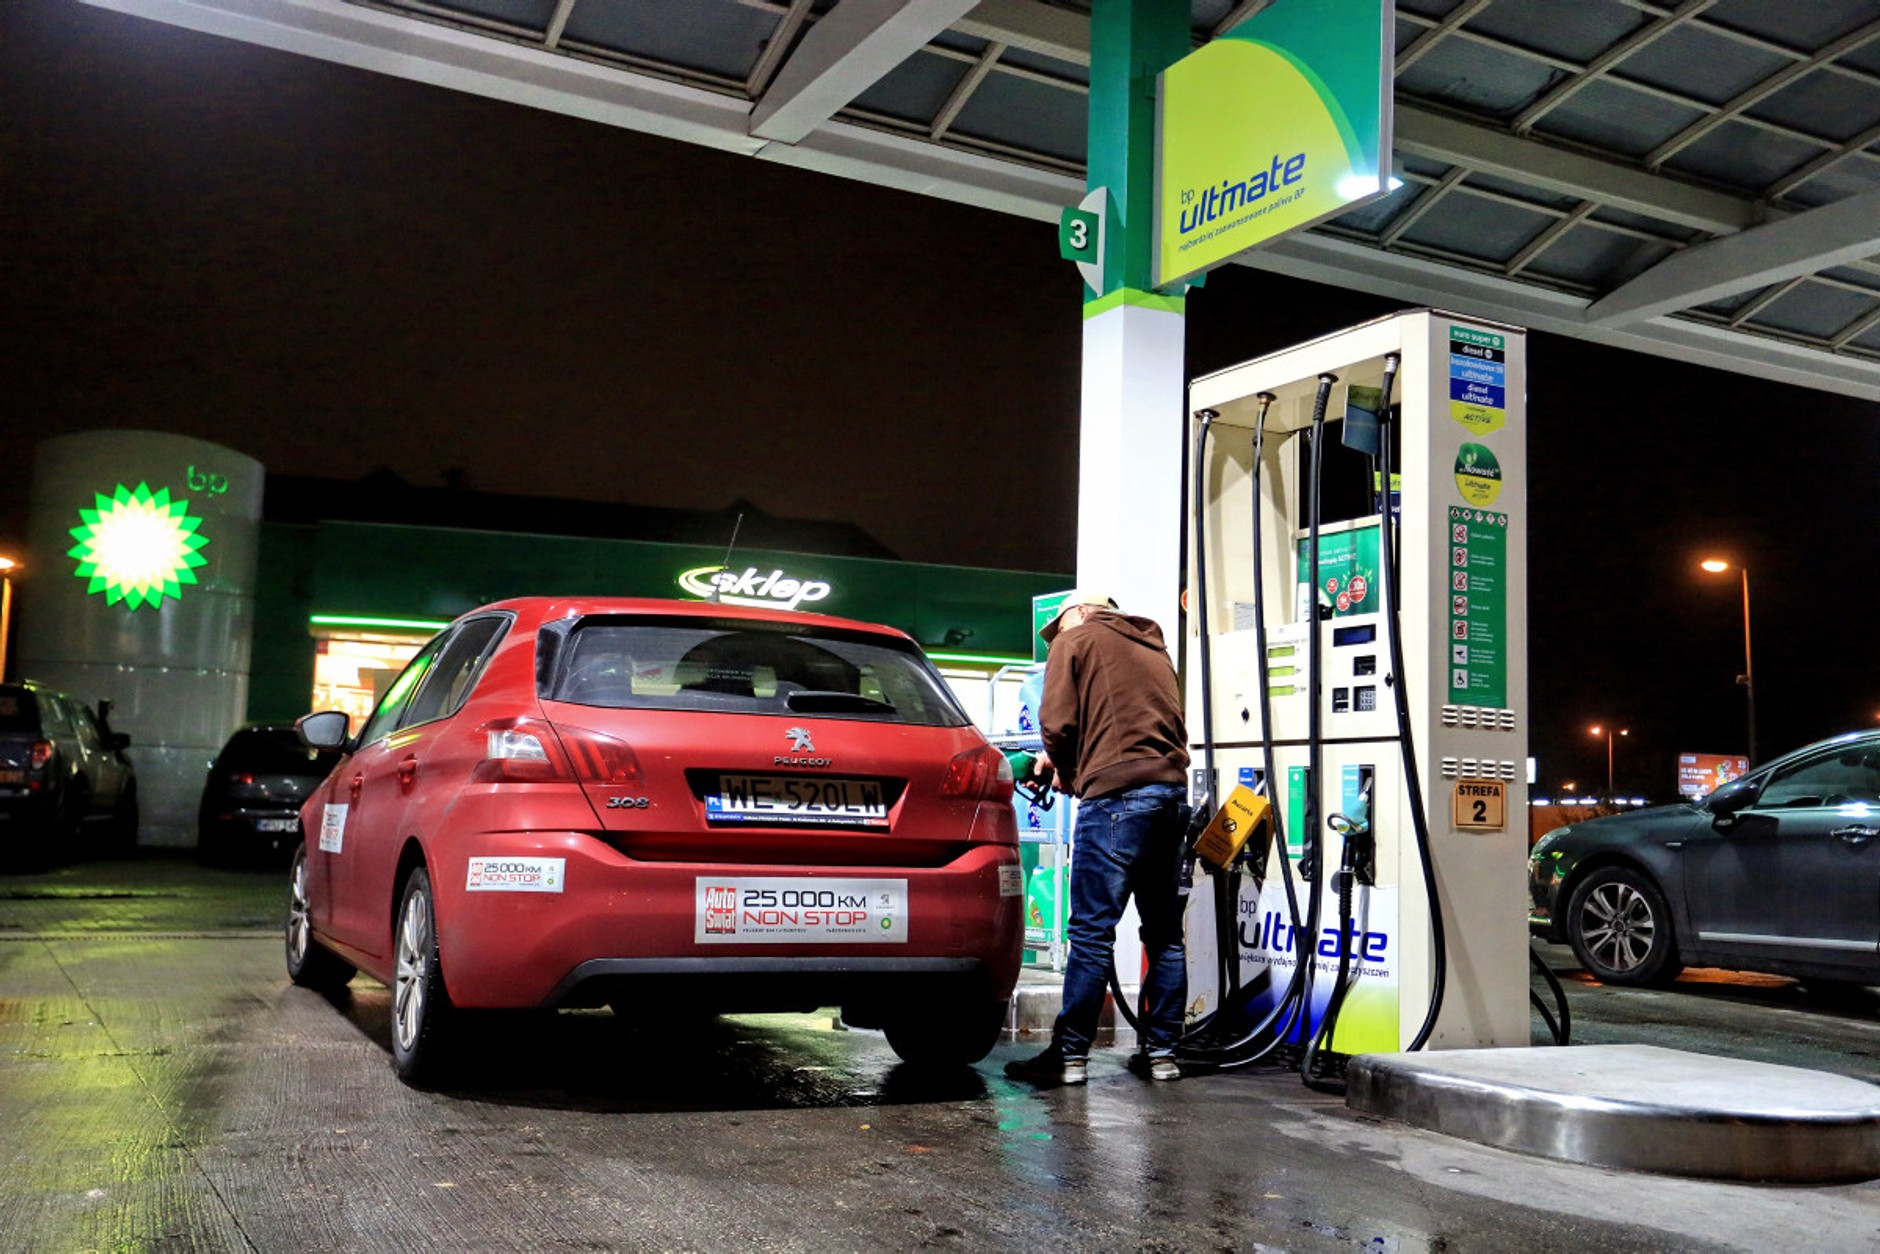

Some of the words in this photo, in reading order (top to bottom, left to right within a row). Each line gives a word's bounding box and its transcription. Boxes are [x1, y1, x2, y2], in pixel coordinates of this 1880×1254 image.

[1180, 153, 1306, 234] ultimate
[1181, 189, 1195, 205] bp
[1069, 219, 1088, 249] 3
[1462, 345, 1484, 357] diesel
[1467, 384, 1488, 394] diesel
[1462, 392, 1494, 405] ultimate
[187, 465, 228, 498] bp
[711, 567, 830, 608] sklep
[774, 756, 832, 767] PEUGEOT
[726, 778, 773, 810] WE
[784, 780, 880, 814] 520LW
[1458, 784, 1500, 797] STREFA
[606, 796, 649, 809] 308
[708, 797, 720, 806] PL
[1473, 800, 1487, 822] 2
[483, 873, 507, 881] NON
[509, 874, 541, 882] STOP
[706, 887, 735, 909] Auto
[743, 890, 778, 908] 25
[782, 891, 835, 908] 000
[838, 896, 867, 908] KM
[1240, 895, 1256, 918] bp
[743, 911, 799, 925] NON
[804, 911, 868, 926] STOP
